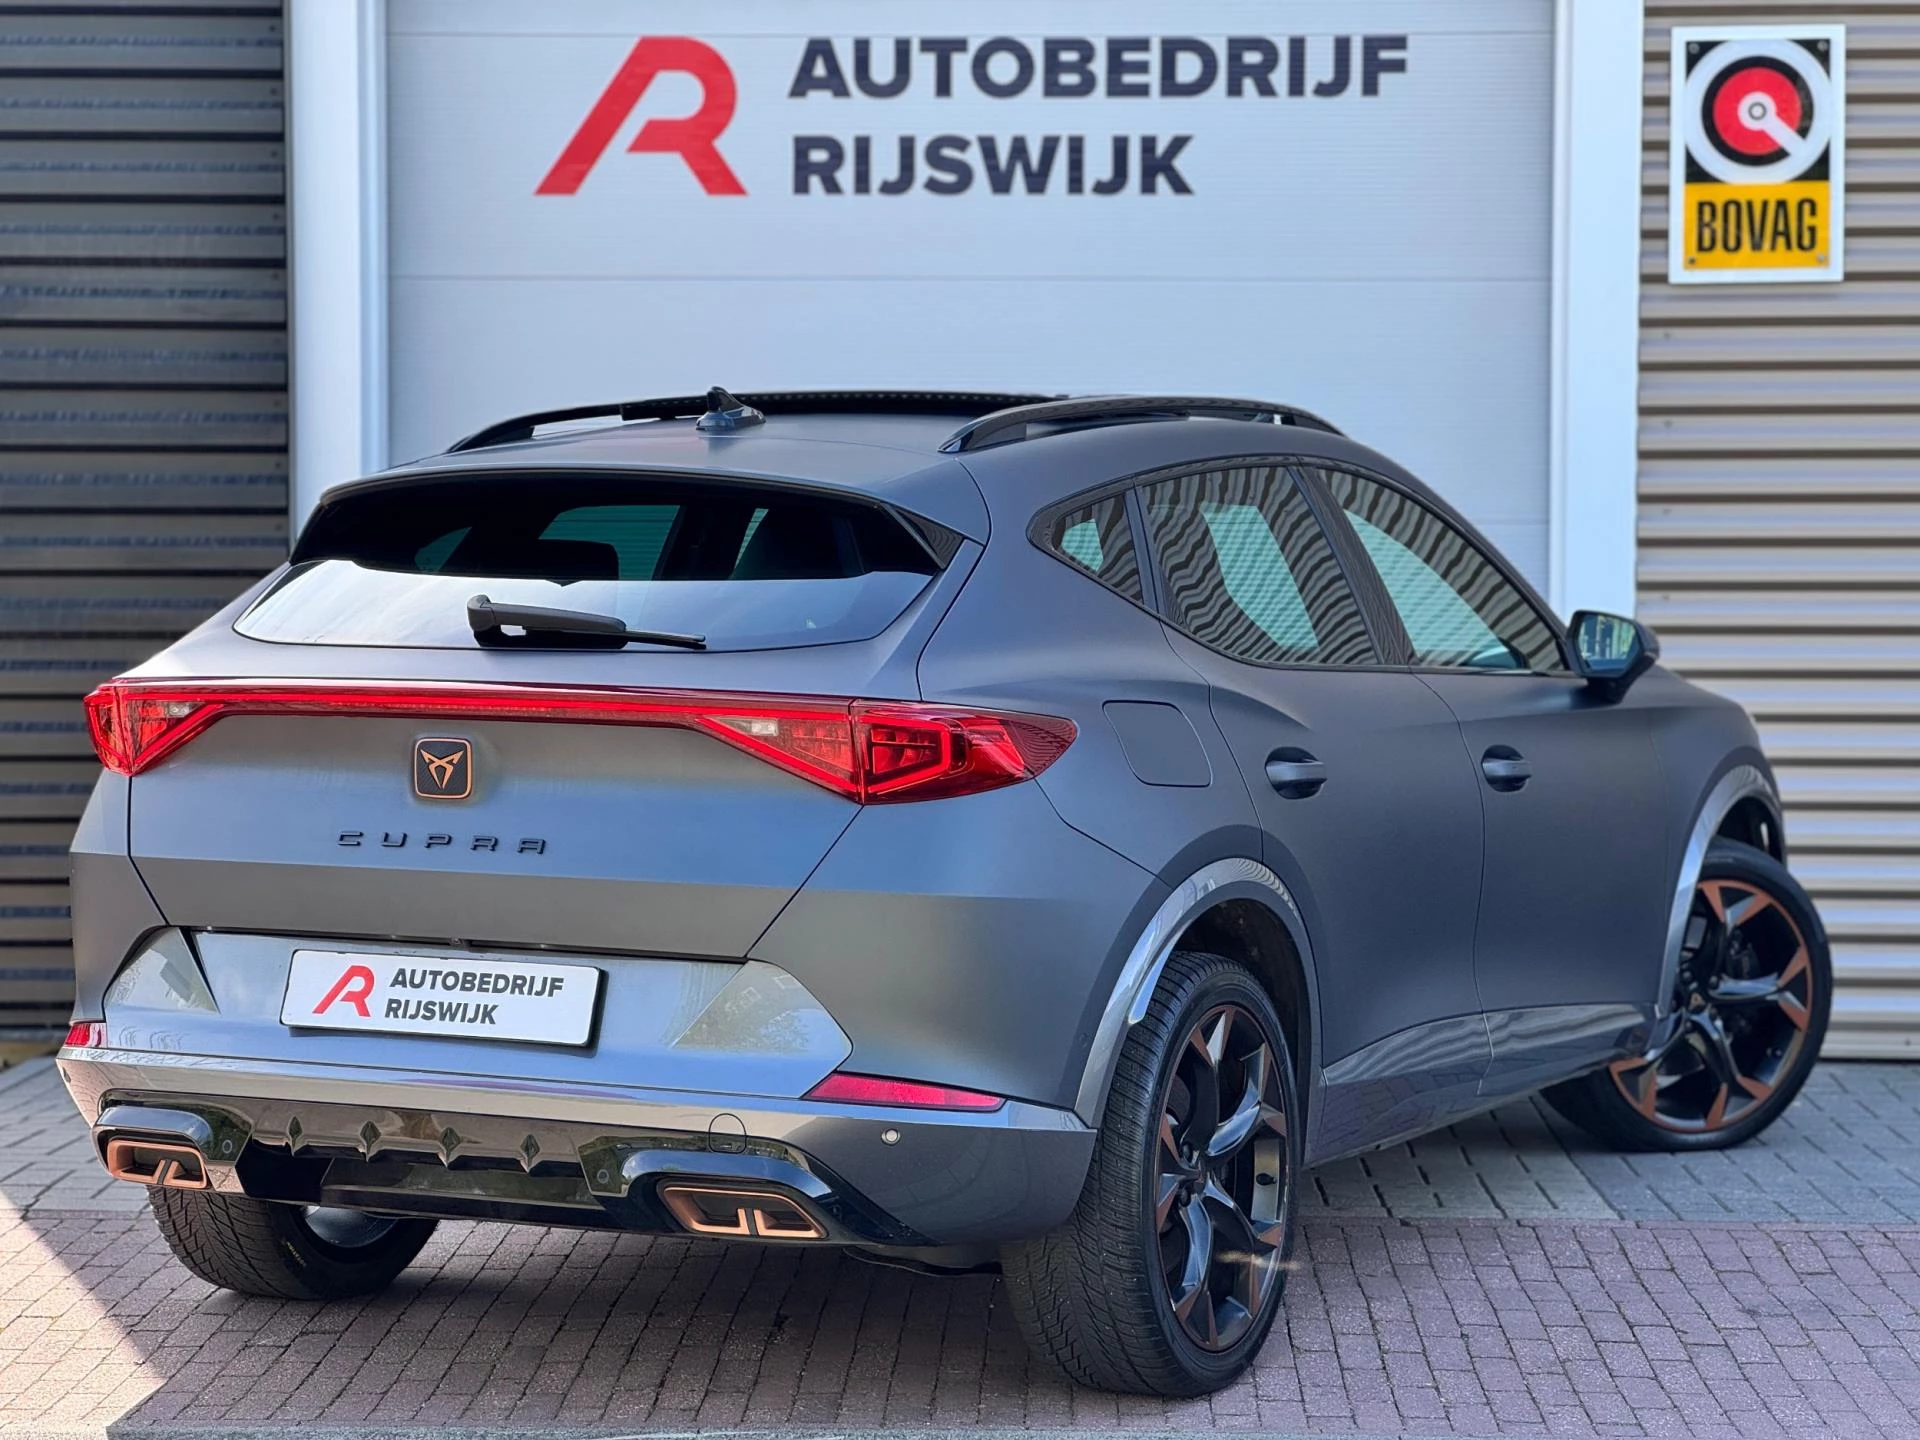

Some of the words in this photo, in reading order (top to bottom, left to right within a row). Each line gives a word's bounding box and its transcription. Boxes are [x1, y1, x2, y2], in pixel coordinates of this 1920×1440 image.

[787, 35, 1408, 98] AUTOBEDRIJF
[793, 135, 1193, 196] RIJSWIJK
[1696, 197, 1818, 253] BOVAG
[338, 830, 546, 855] CUPRA
[389, 967, 565, 998] AUTOBEDRIJF
[384, 998, 499, 1025] RIJSWIJK
